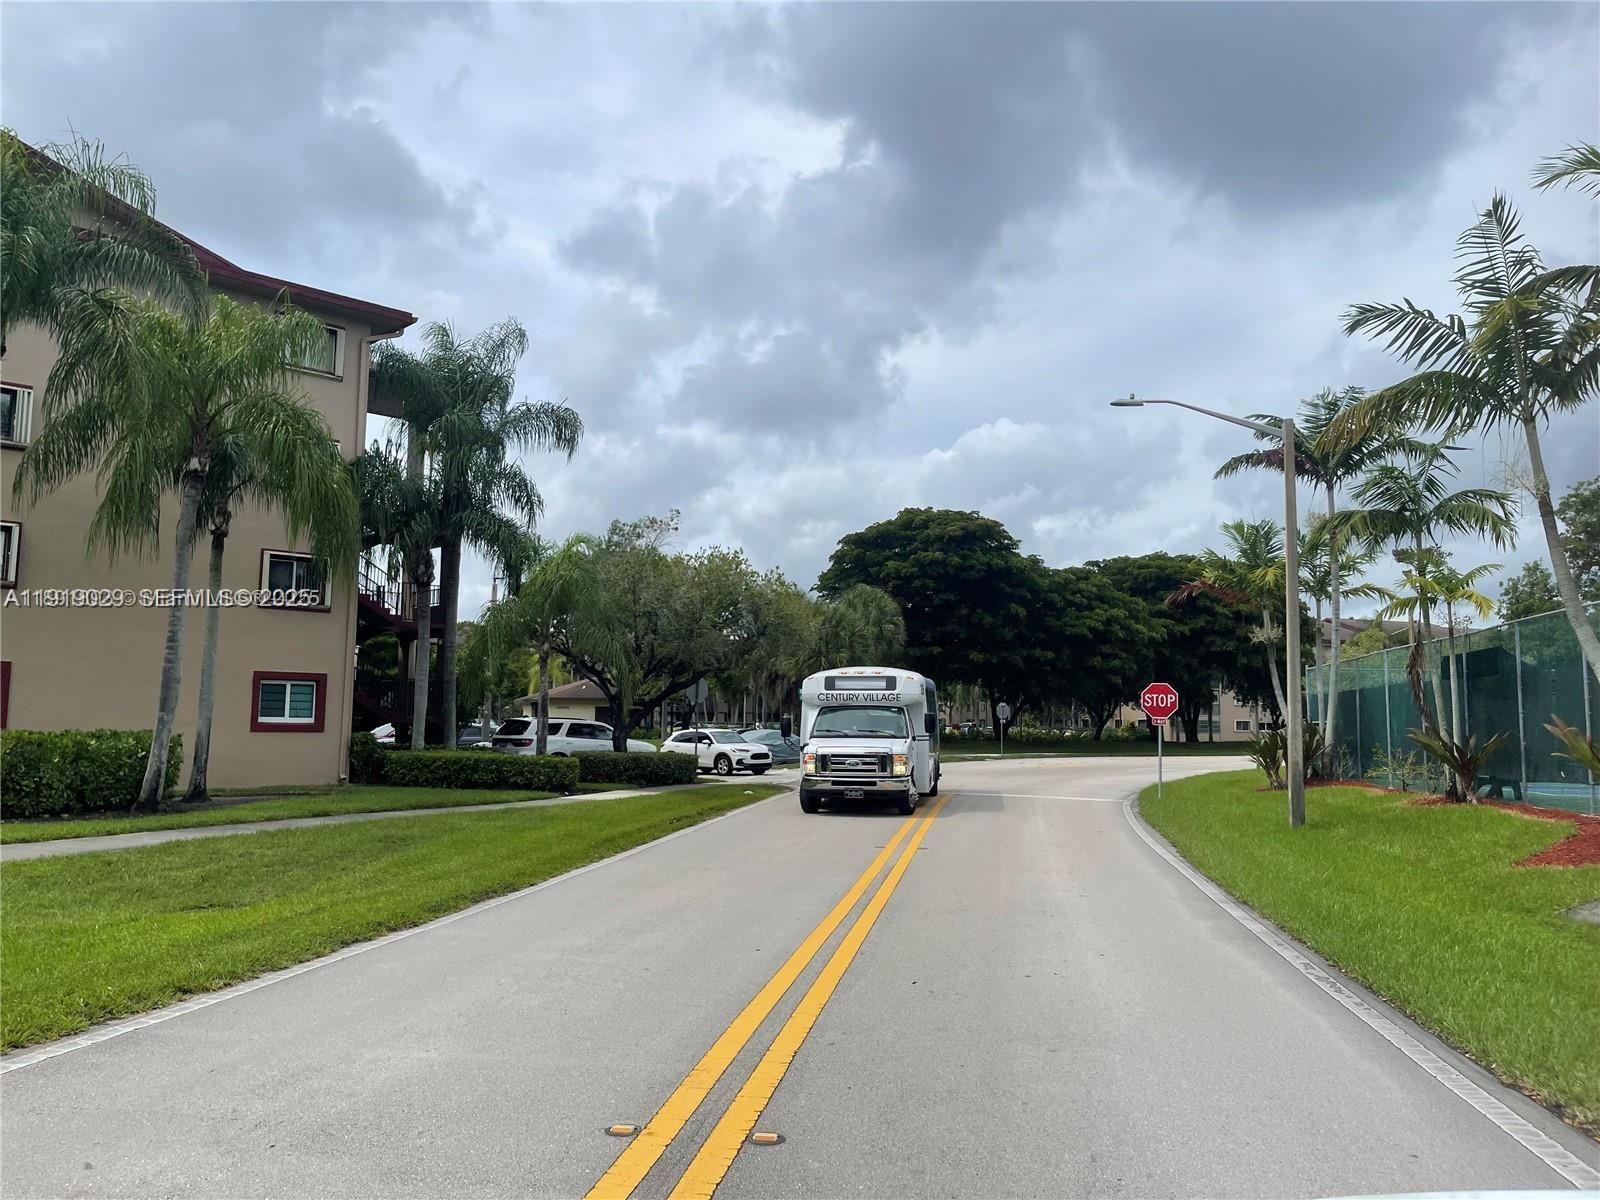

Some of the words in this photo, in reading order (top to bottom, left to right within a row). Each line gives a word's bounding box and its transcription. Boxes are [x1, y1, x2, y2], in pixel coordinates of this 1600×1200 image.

[817, 692, 860, 702] CENTURY
[863, 692, 902, 702] VILLAGE
[1144, 693, 1176, 707] STOP
